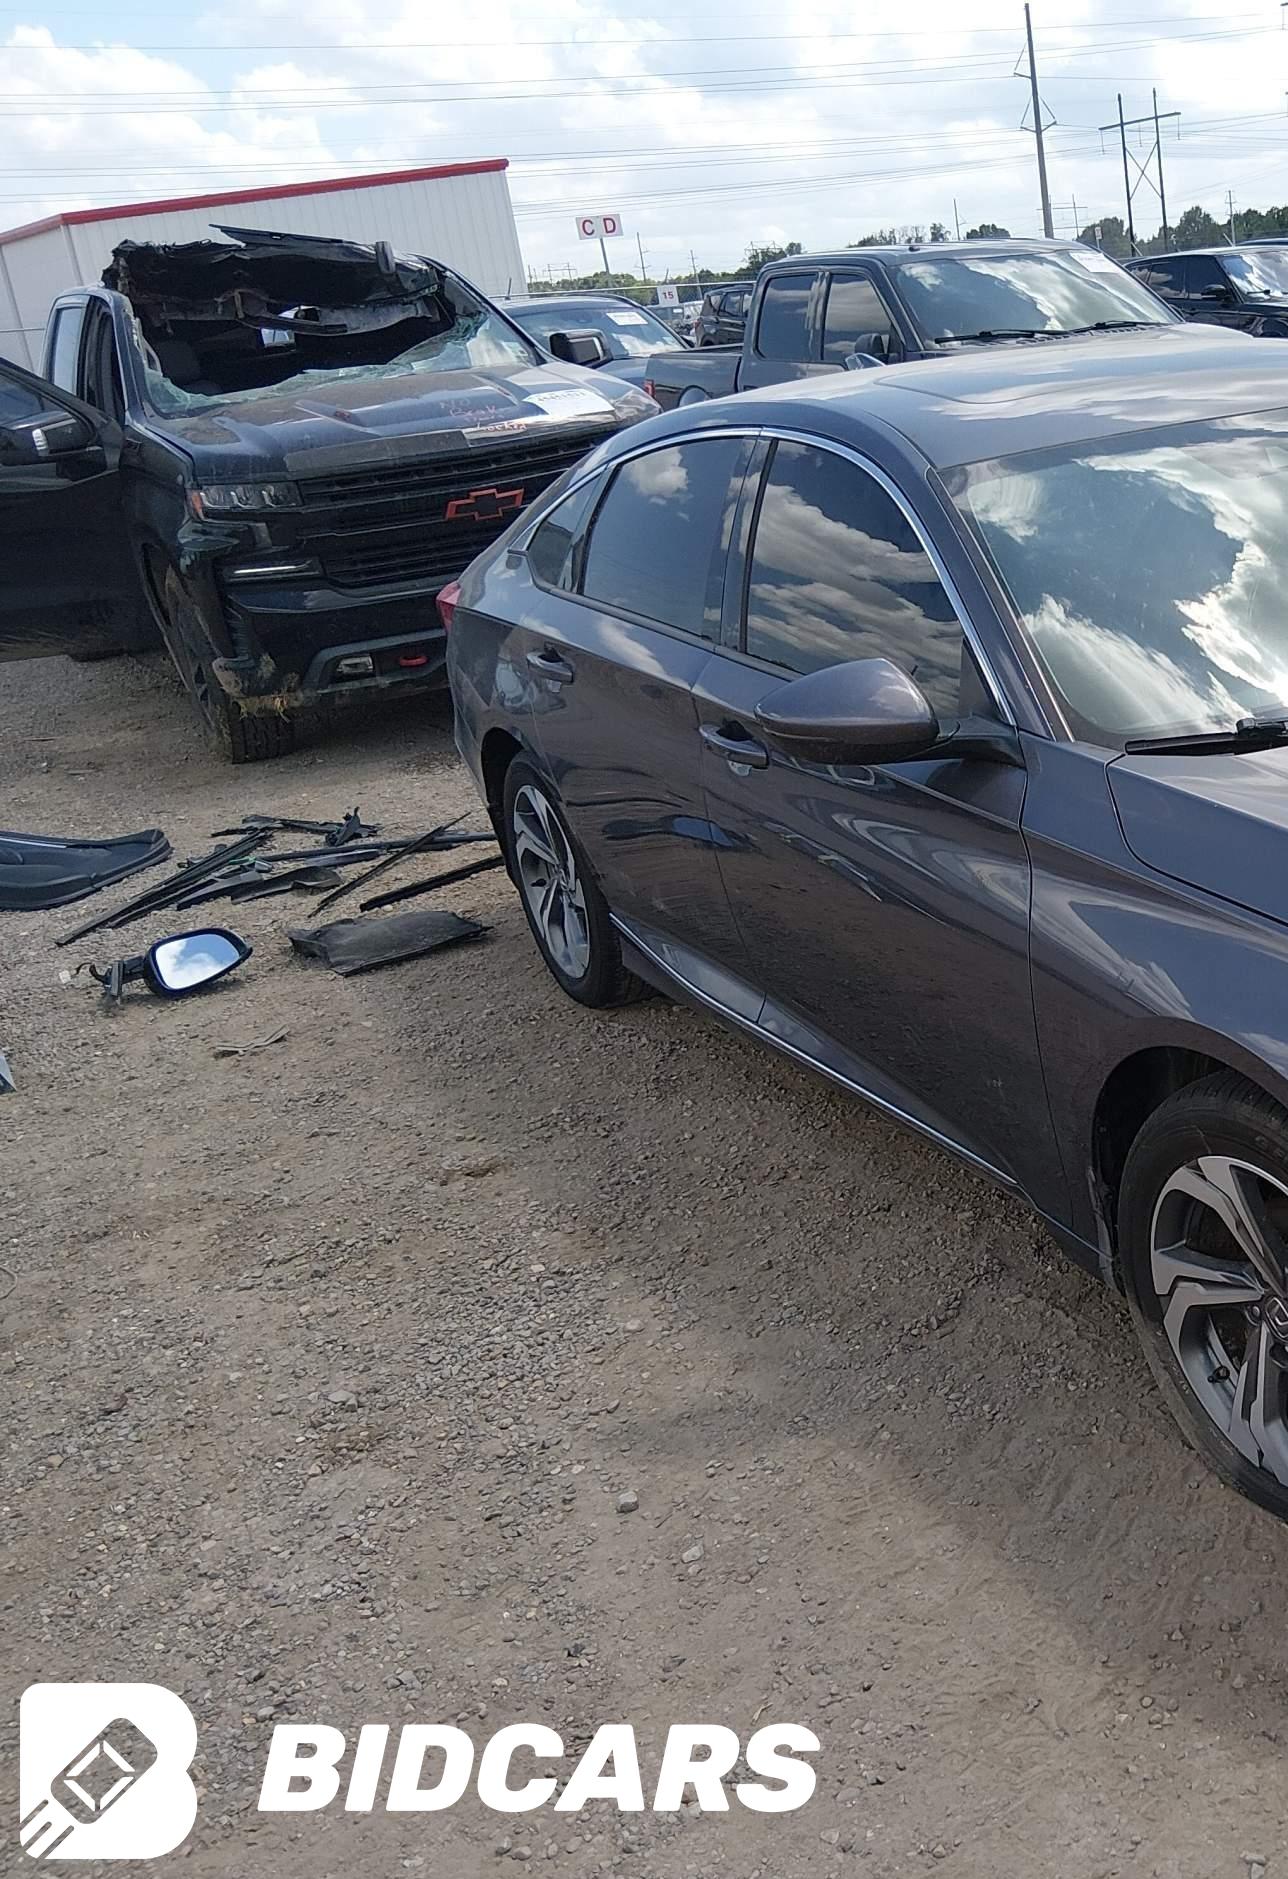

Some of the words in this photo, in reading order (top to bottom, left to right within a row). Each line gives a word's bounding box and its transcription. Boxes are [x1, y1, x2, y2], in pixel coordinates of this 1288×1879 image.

[582, 219, 595, 236] C
[603, 217, 617, 234] D
[662, 290, 675, 300] 15
